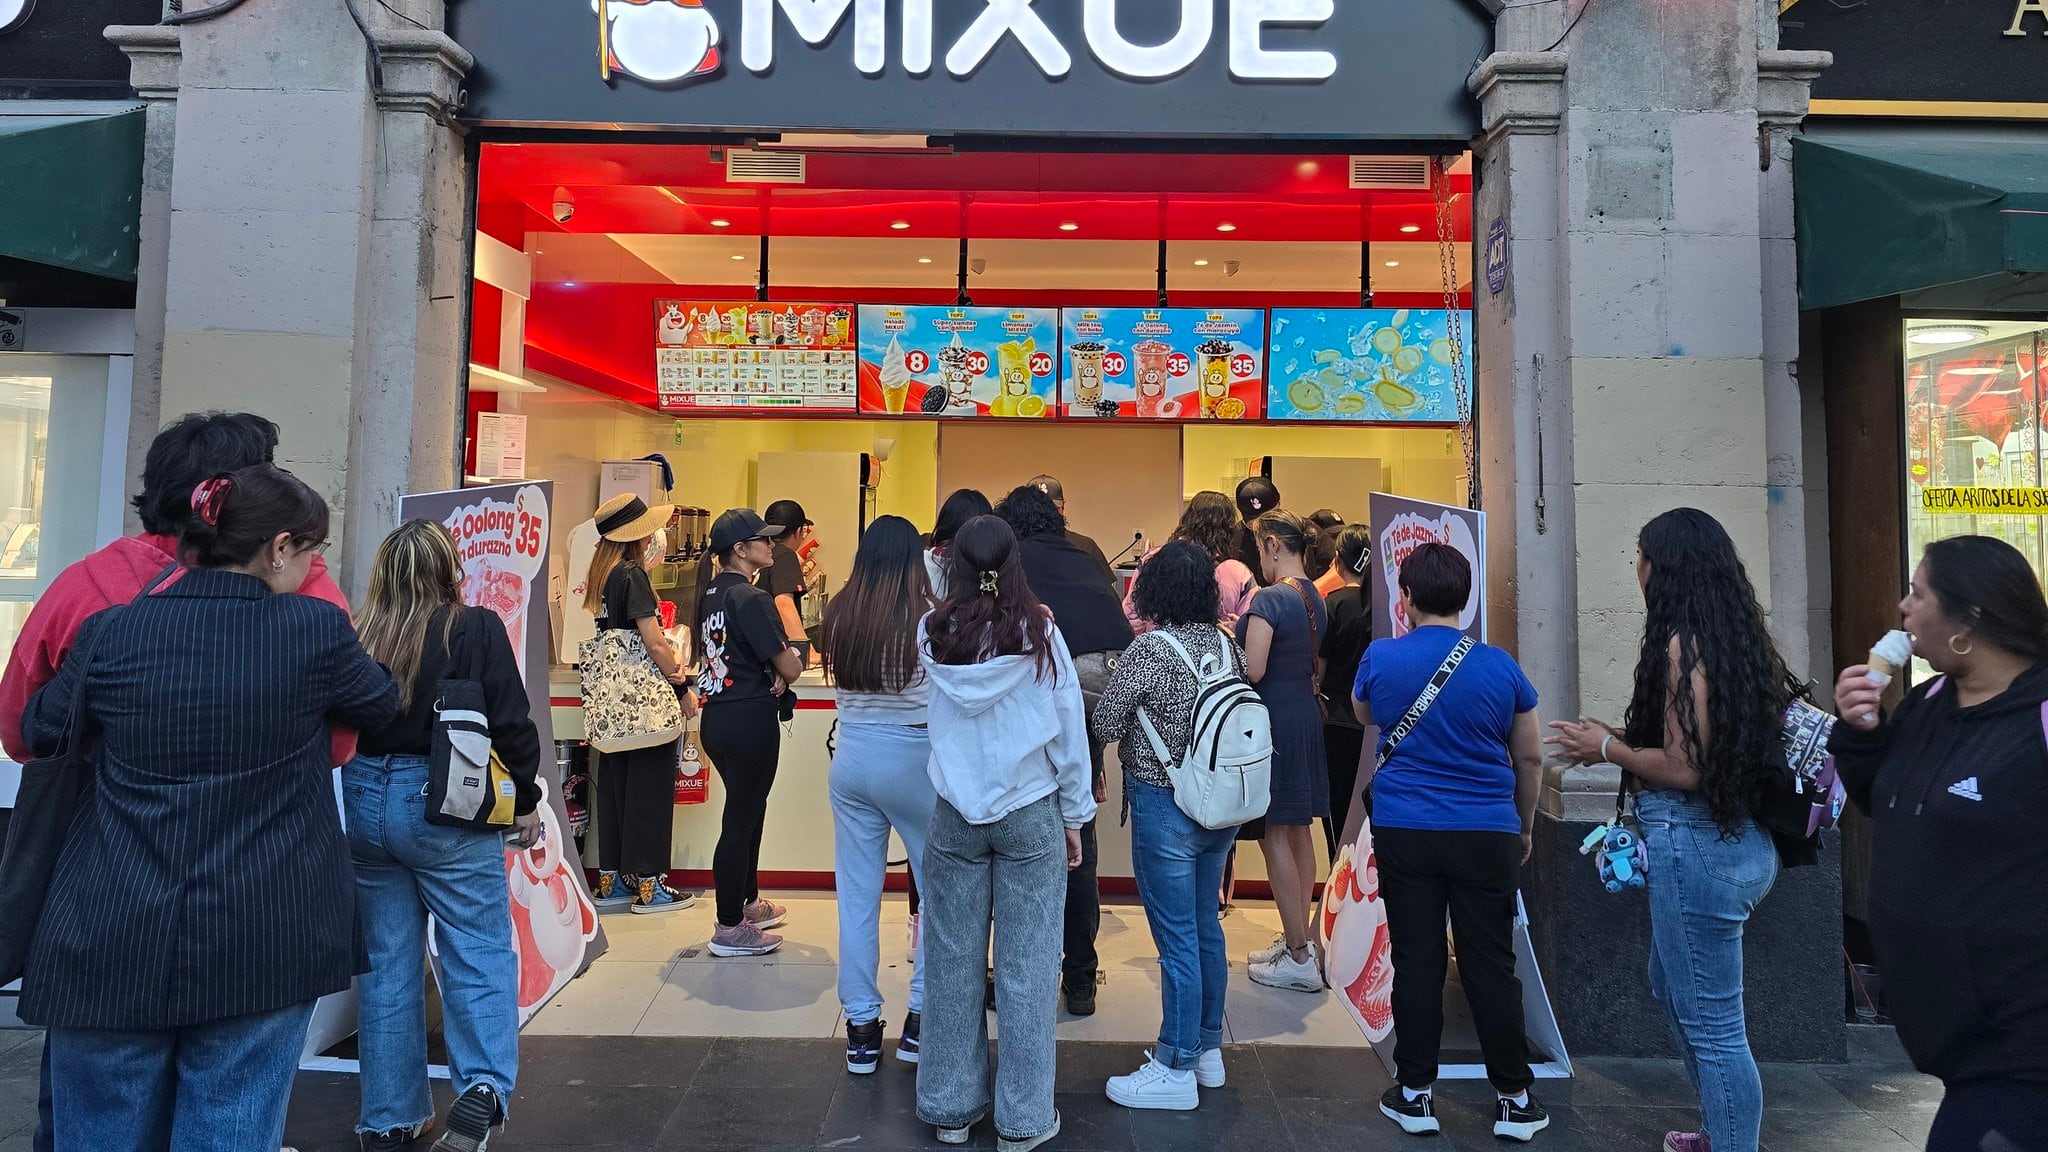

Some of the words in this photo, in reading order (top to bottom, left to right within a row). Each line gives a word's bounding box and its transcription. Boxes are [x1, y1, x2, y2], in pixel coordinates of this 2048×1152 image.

[740, 0, 1337, 78] MIXUE
[1489, 236, 1504, 268] ADT
[669, 395, 696, 403] MIXUE
[1922, 487, 1962, 509] OFERTA
[2001, 488, 2016, 506] DE
[2017, 488, 2032, 508] LA
[463, 507, 515, 540] Oolong
[1392, 524, 1401, 547] Té
[1401, 523, 1411, 542] de
[467, 539, 511, 559] durazno
[674, 779, 703, 788] MIXUE
